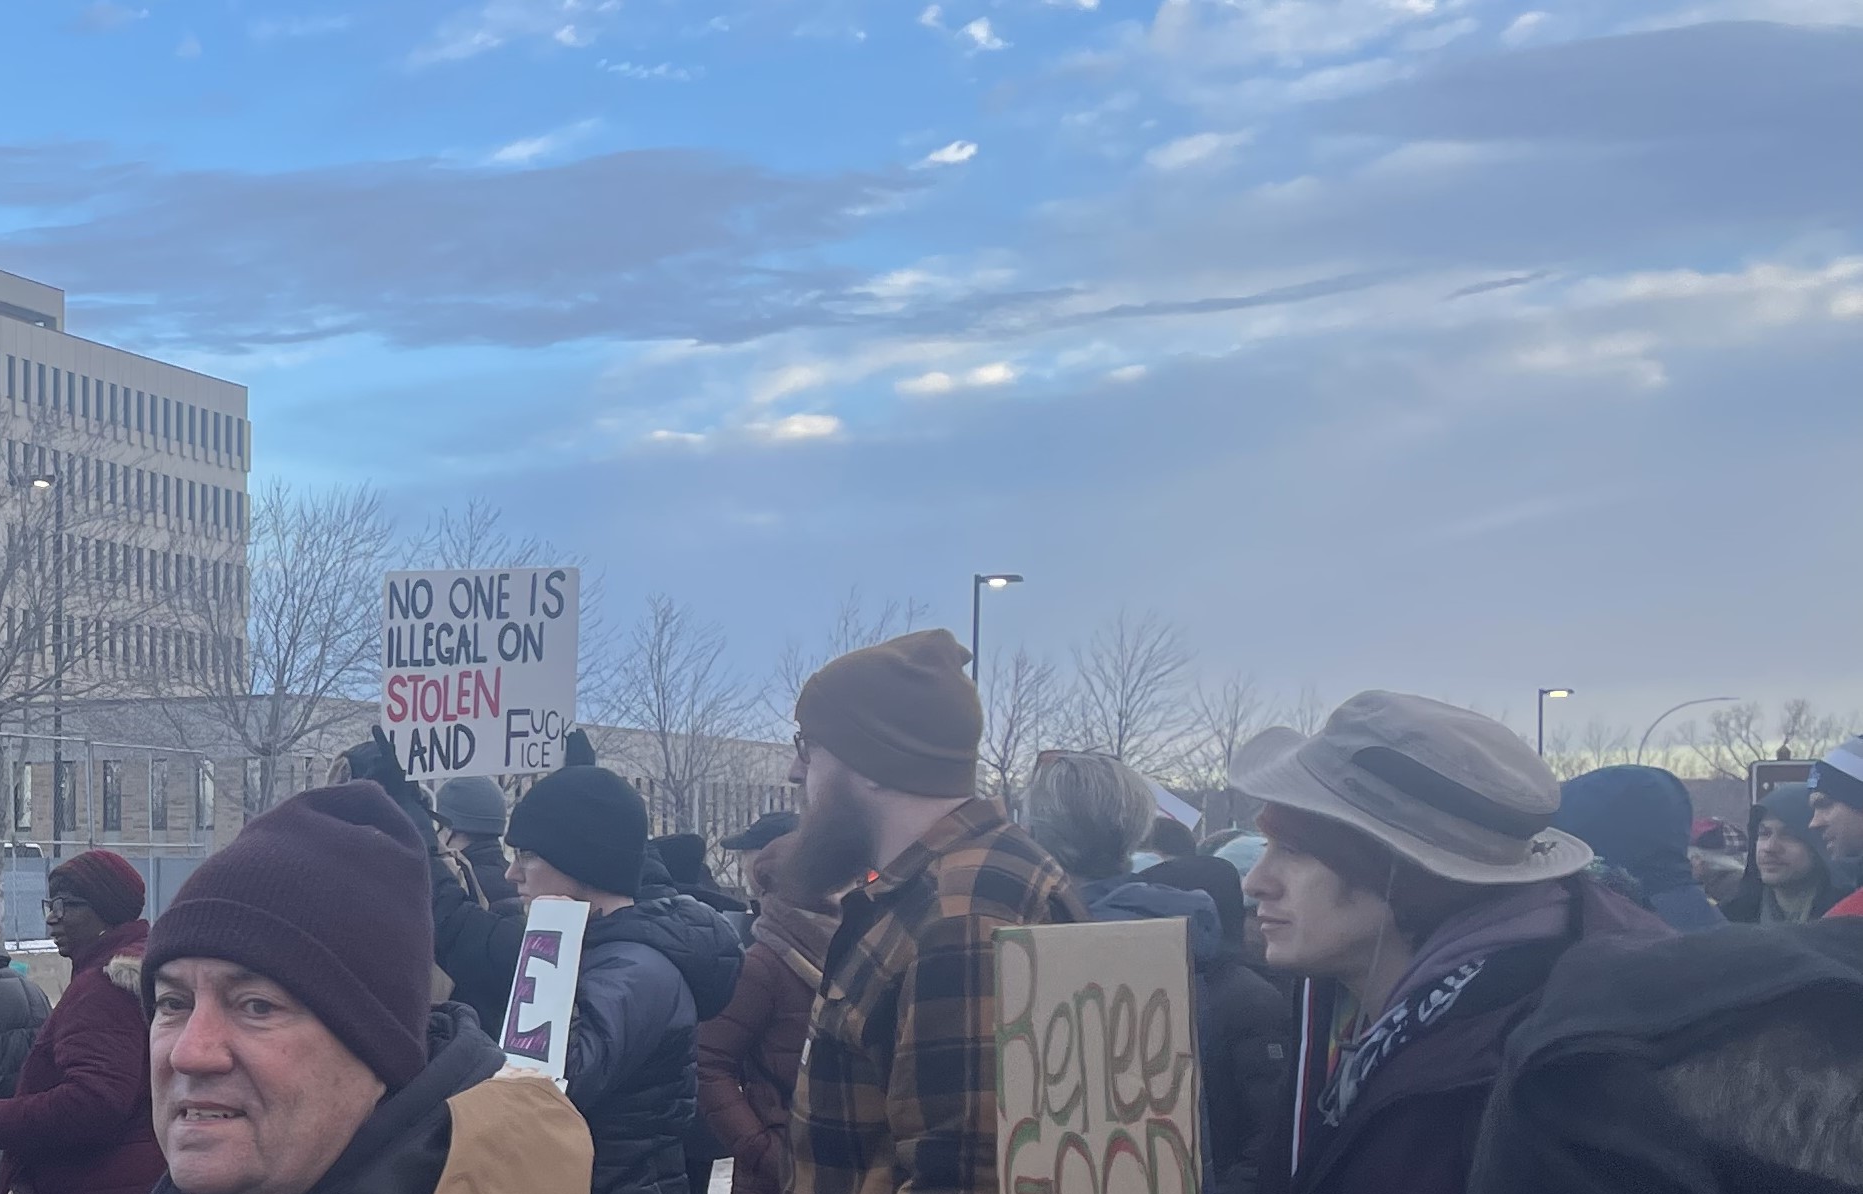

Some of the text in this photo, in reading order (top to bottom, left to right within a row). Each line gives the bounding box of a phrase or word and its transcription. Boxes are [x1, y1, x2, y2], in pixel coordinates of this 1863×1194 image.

[388, 570, 566, 621] NO ONE IS
[387, 622, 544, 668] ILLEGAL ON
[386, 667, 501, 723] STOLEN
[504, 709, 573, 767] FUCK
[521, 741, 551, 768] ICE
